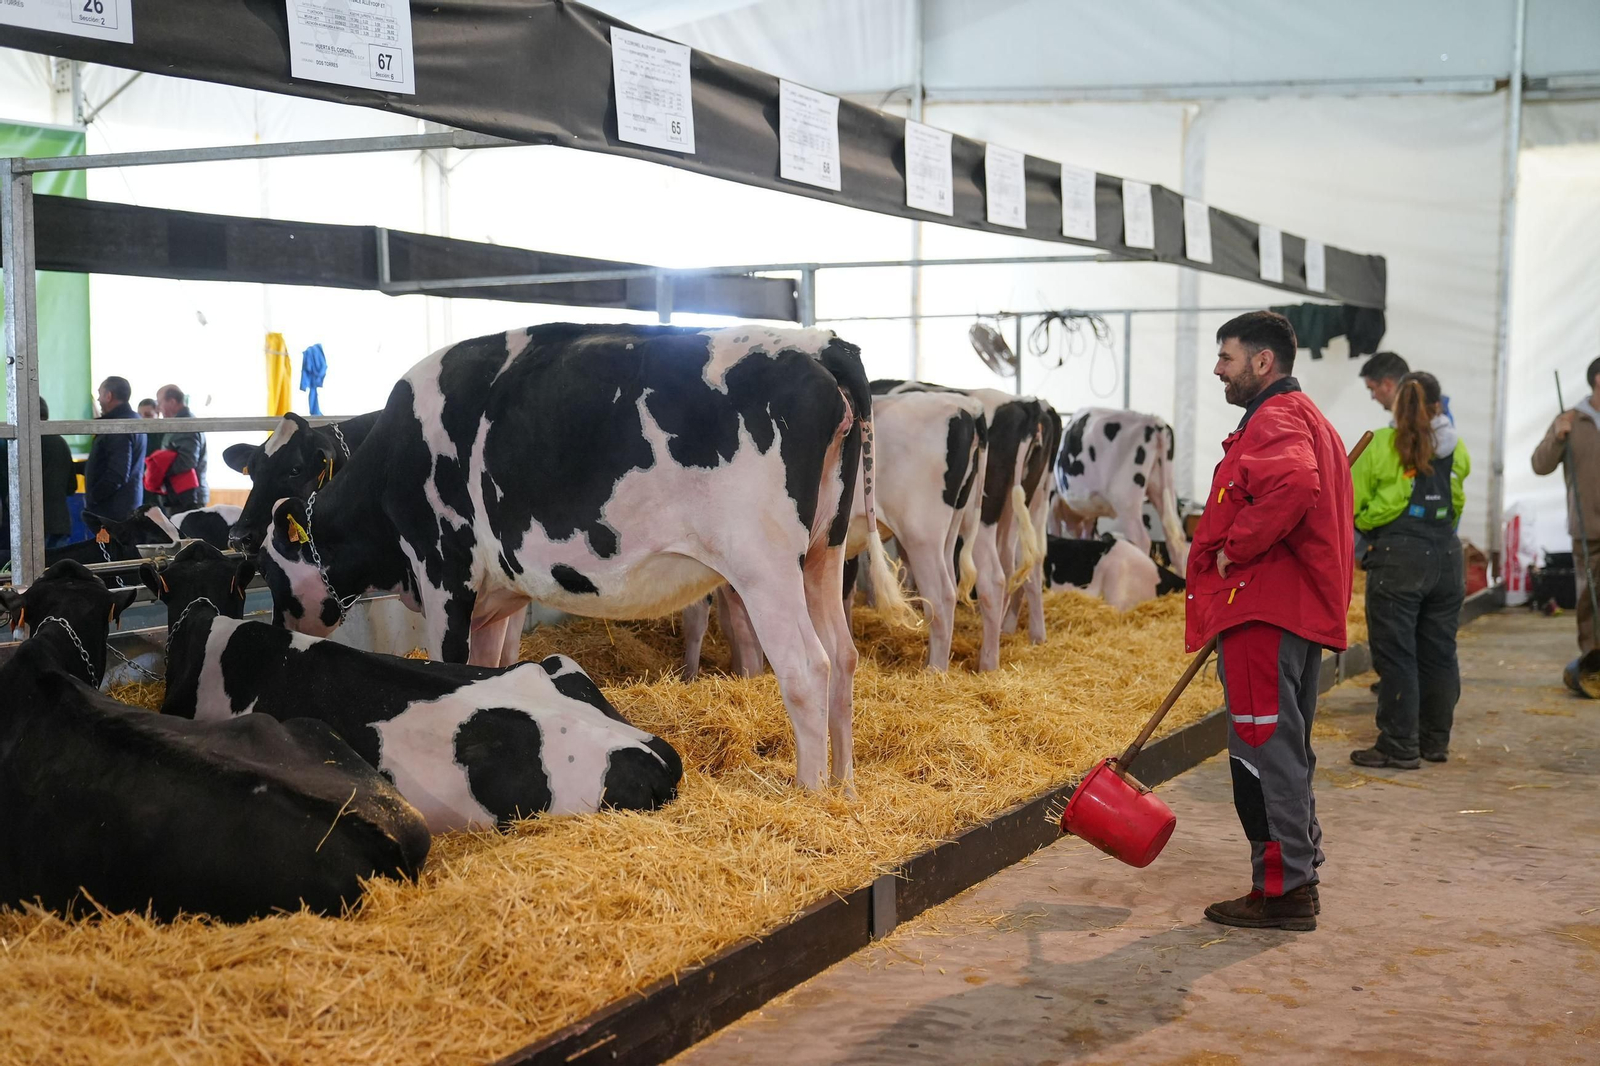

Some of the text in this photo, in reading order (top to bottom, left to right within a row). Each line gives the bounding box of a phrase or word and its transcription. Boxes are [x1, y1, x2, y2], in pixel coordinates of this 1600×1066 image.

[83, 0, 104, 14] 26
[101, 18, 106, 26] 2
[315, 43, 331, 51] HUERTA
[337, 46, 355, 56] CORONEL
[378, 53, 393, 71] 67
[671, 120, 682, 135] 65
